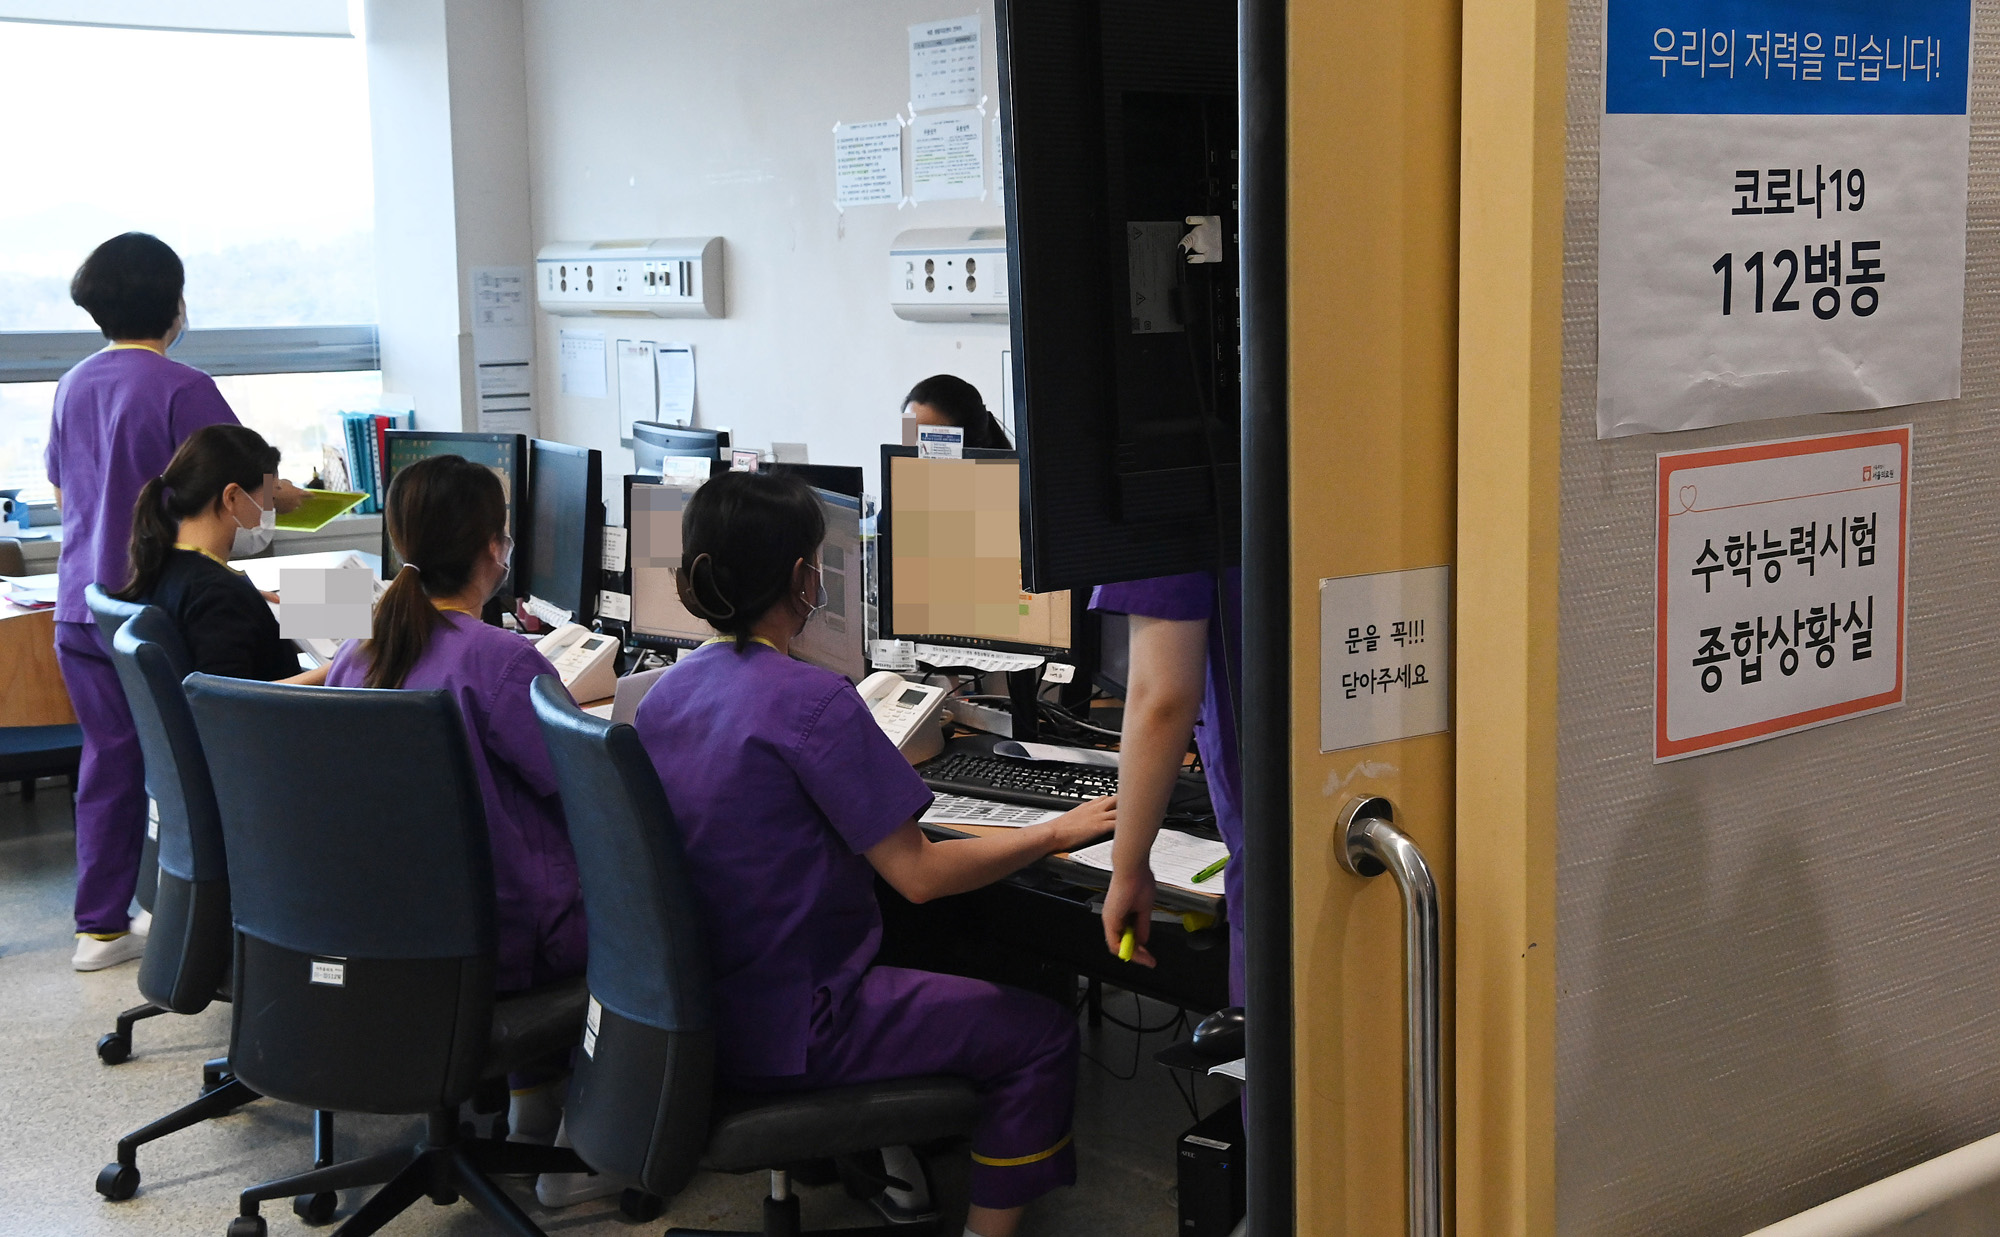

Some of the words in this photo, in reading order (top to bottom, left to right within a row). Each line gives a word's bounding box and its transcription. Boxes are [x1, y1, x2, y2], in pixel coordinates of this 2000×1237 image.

[1649, 27, 1735, 79] 우리의
[1745, 31, 1826, 82] 저력을
[1834, 33, 1941, 82] 믿습니다!
[1731, 164, 1866, 219] 코로나19
[1712, 239, 1886, 321] 112병동
[1691, 511, 1877, 593] 수학능력시험
[1344, 624, 1381, 655] 문을
[1390, 619, 1425, 648] 꼭!!!
[1692, 595, 1874, 693] 종합상황실
[1342, 663, 1429, 700] 닫아주세요
